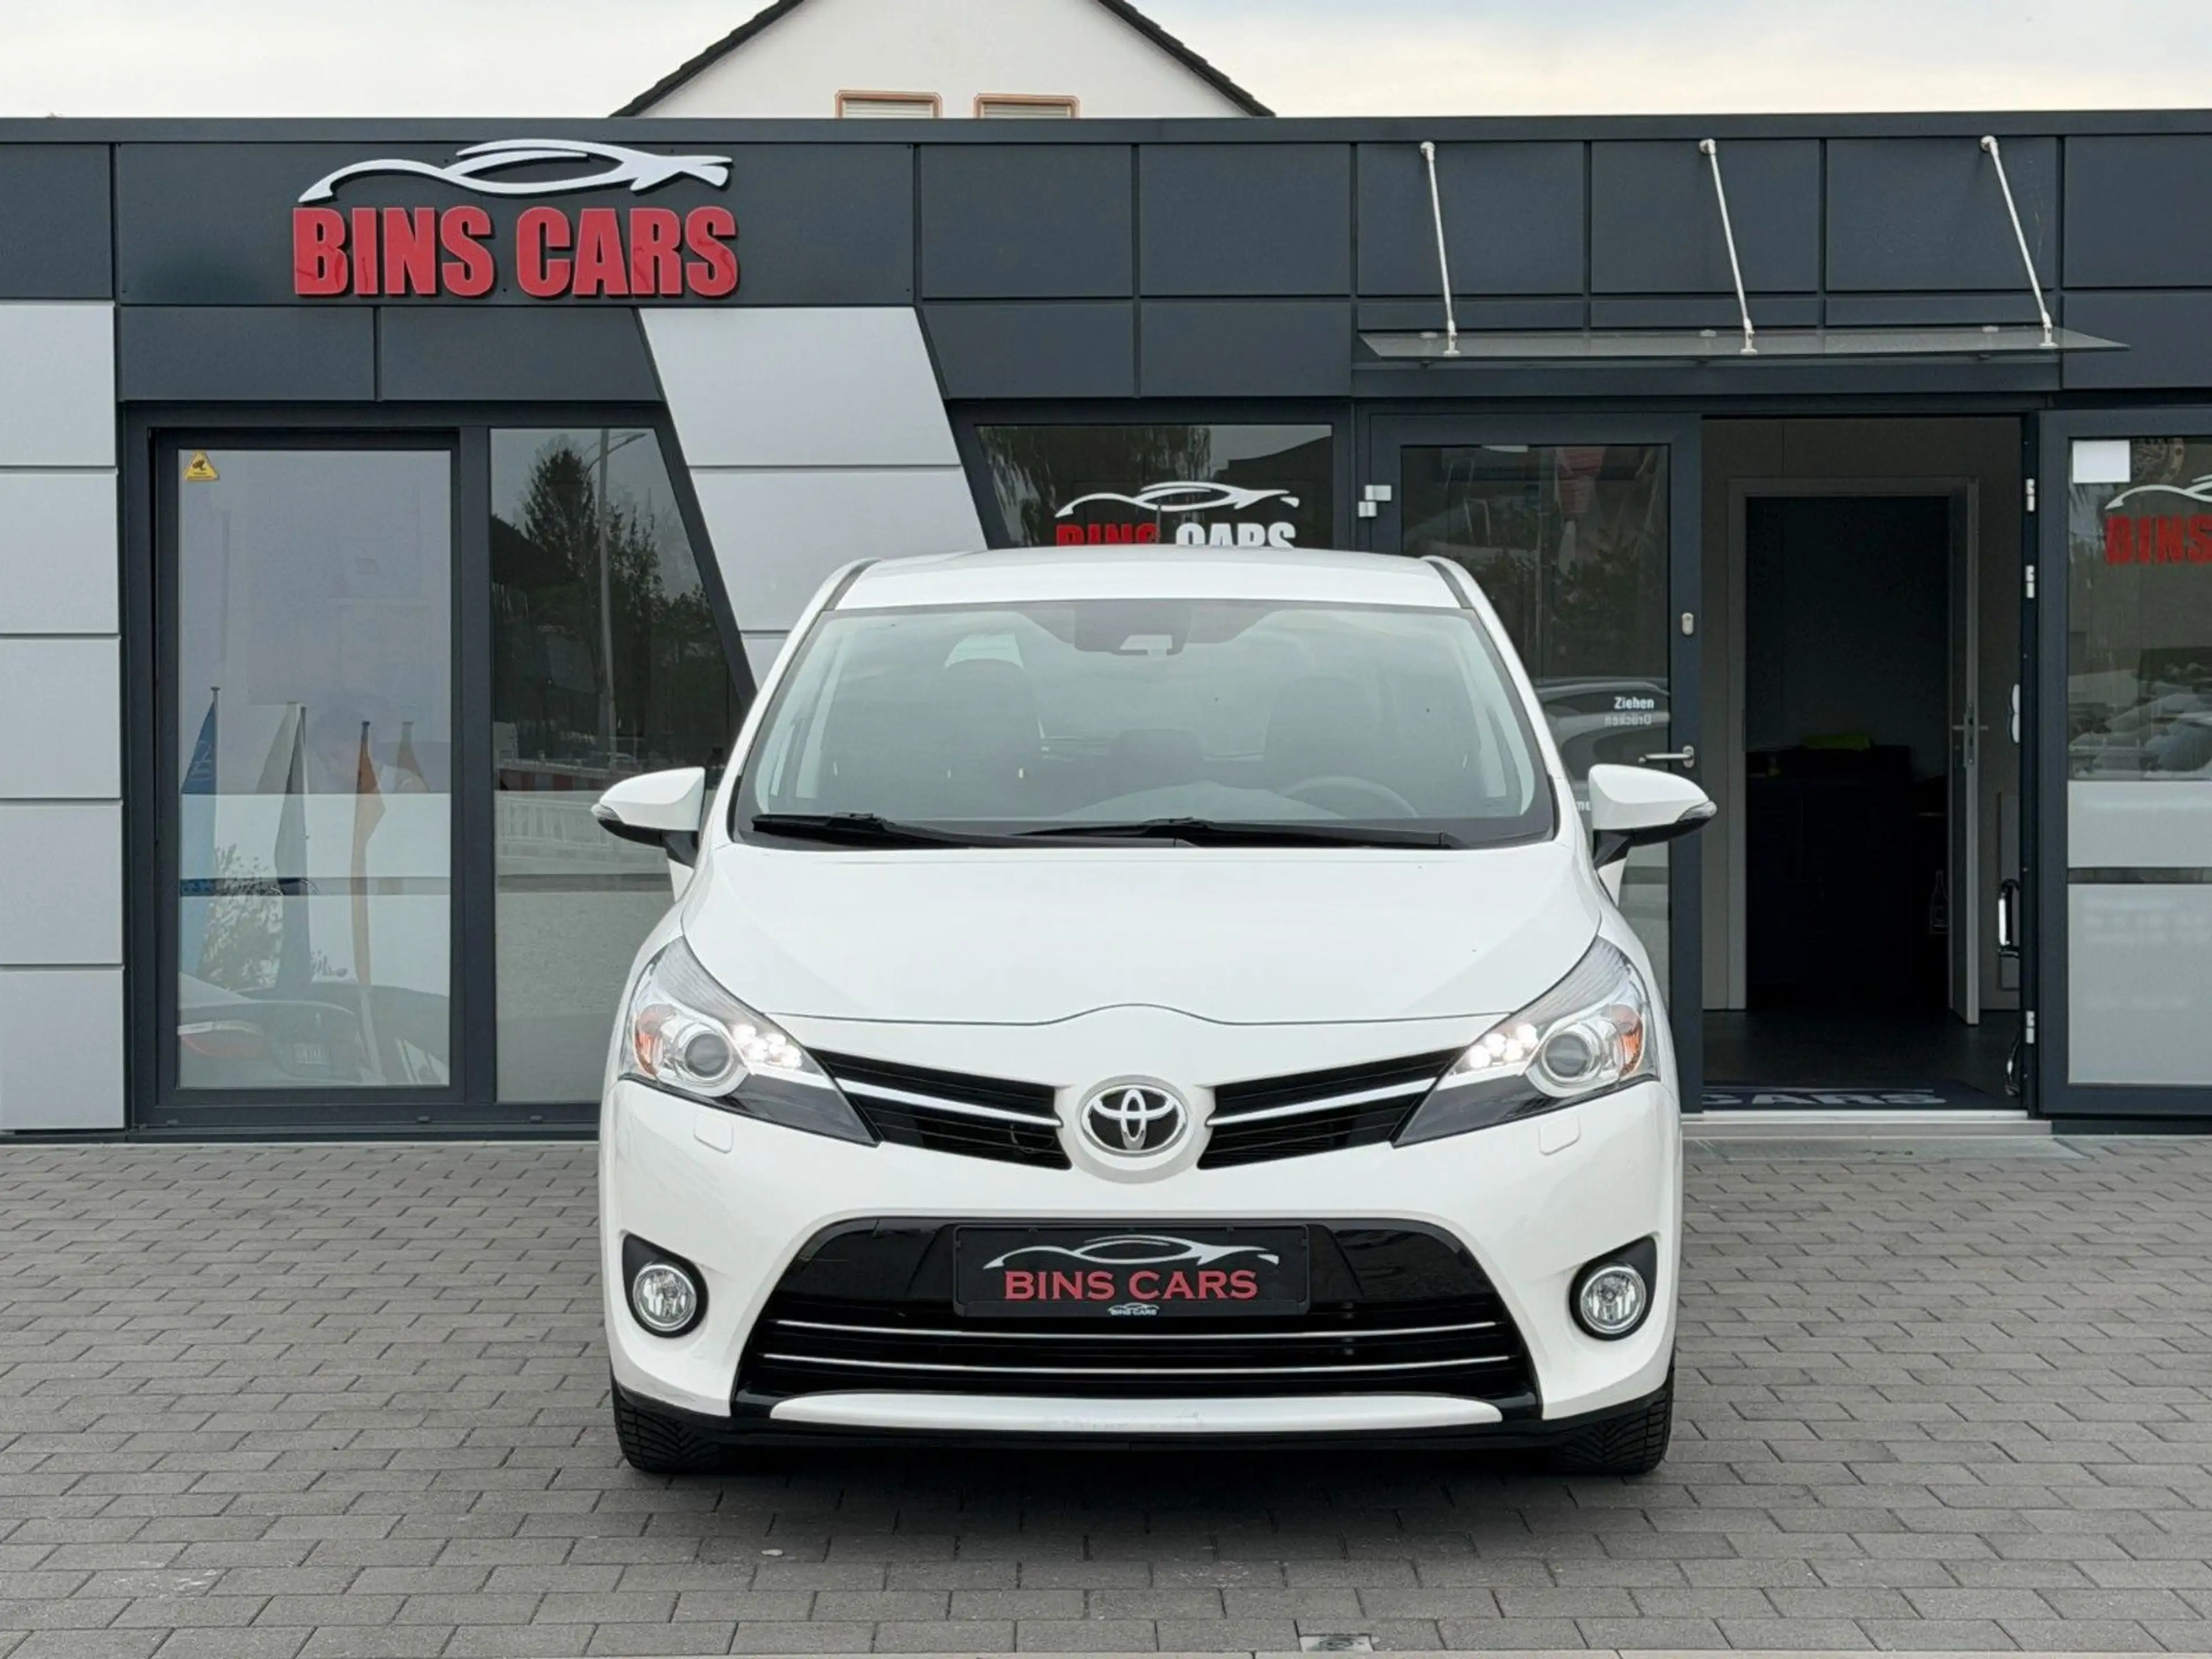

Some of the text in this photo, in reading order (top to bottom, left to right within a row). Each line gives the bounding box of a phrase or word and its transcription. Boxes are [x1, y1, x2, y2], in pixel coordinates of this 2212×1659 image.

[293, 206, 738, 297] BINS CARS
[1614, 696, 1654, 709] Ziehen
[1005, 1270, 1258, 1300] BINS CARS
